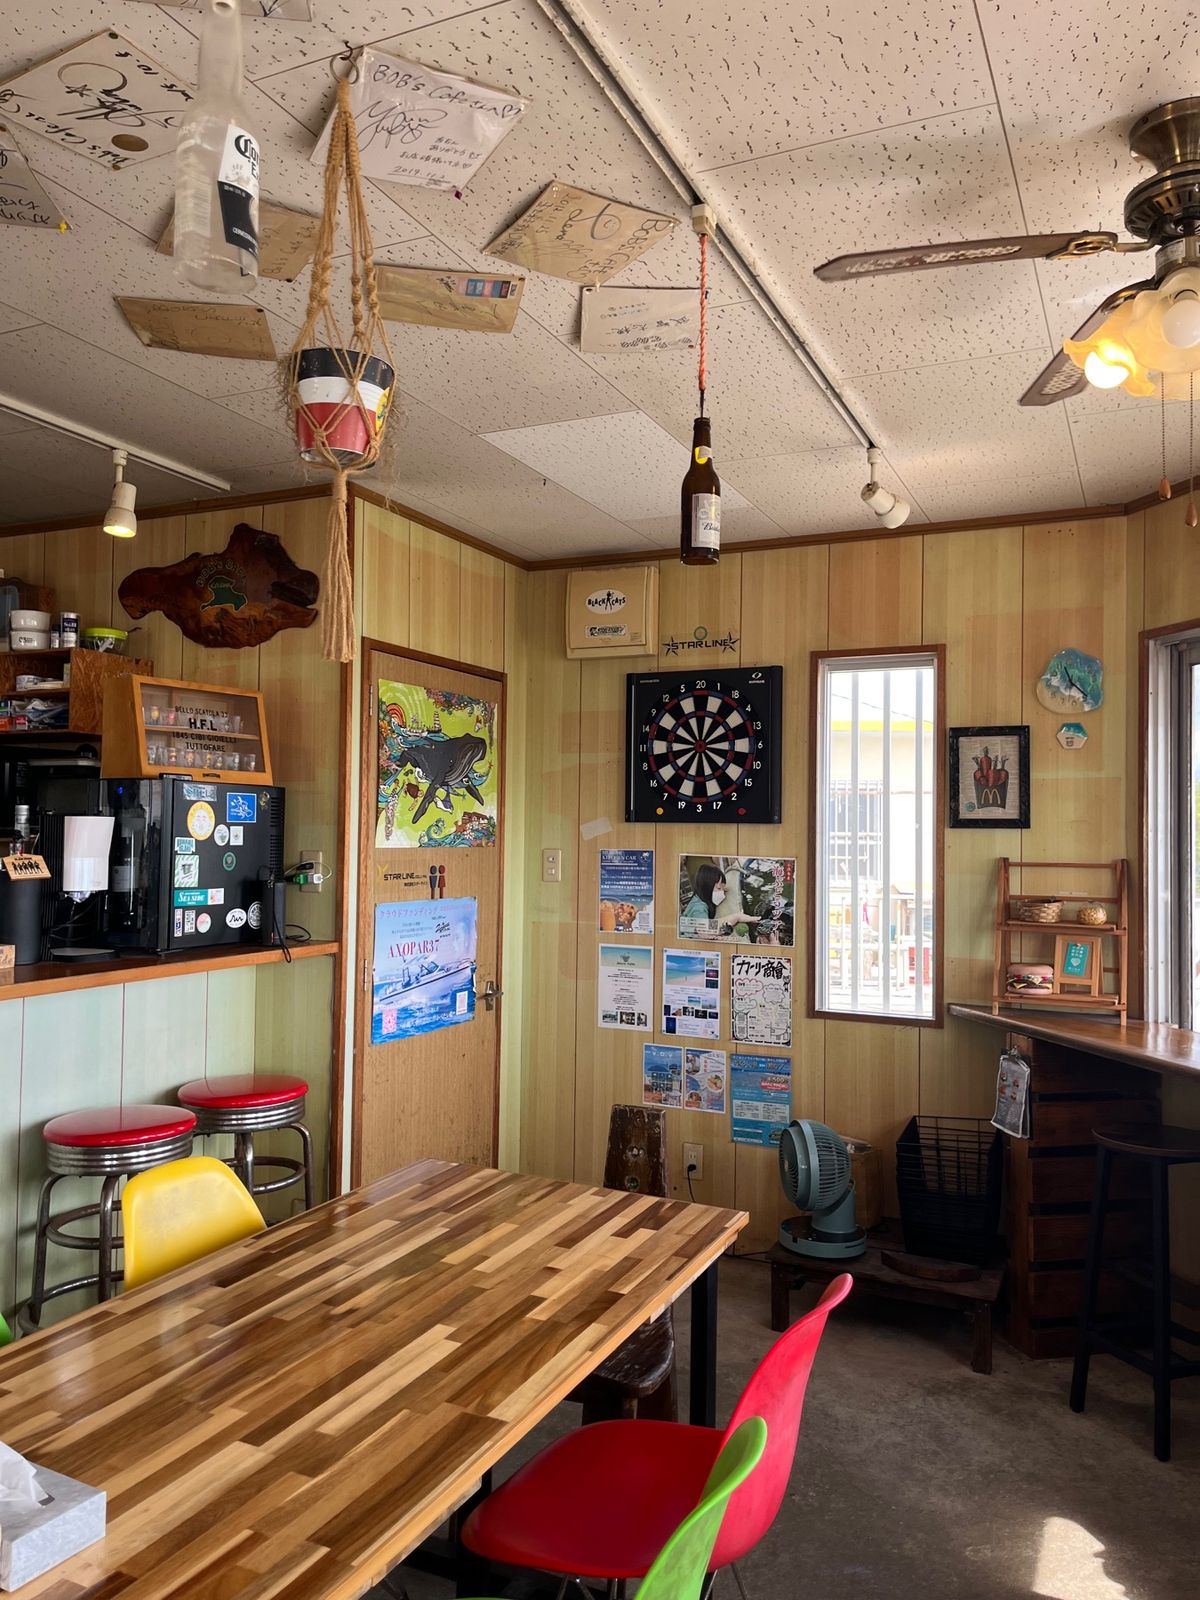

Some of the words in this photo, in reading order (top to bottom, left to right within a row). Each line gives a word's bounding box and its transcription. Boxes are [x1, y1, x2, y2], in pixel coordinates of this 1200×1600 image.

[587, 597, 606, 607] BLACK
[611, 596, 626, 606] CATS
[680, 684, 685, 693] 5
[695, 680, 706, 689] 20
[717, 683, 720, 691] 1
[662, 694, 670, 703] 12
[731, 690, 740, 698] 18
[175, 705, 194, 714] BELLO
[195, 708, 219, 717] SCATOLA
[746, 704, 751, 712] 4
[651, 709, 656, 717] 9
[189, 718, 218, 731] H.F.L
[753, 721, 761, 730] 13
[185, 742, 226, 752] TUTTOFARE
[640, 744, 646, 752] 11
[758, 740, 763, 748] 6
[753, 761, 761, 769] 10
[744, 779, 752, 787] 15
[731, 792, 737, 801] 2
[678, 801, 686, 809] 19
[696, 805, 702, 813] 3
[713, 801, 722, 810] 17
[388, 939, 440, 958] AXOPAR37
